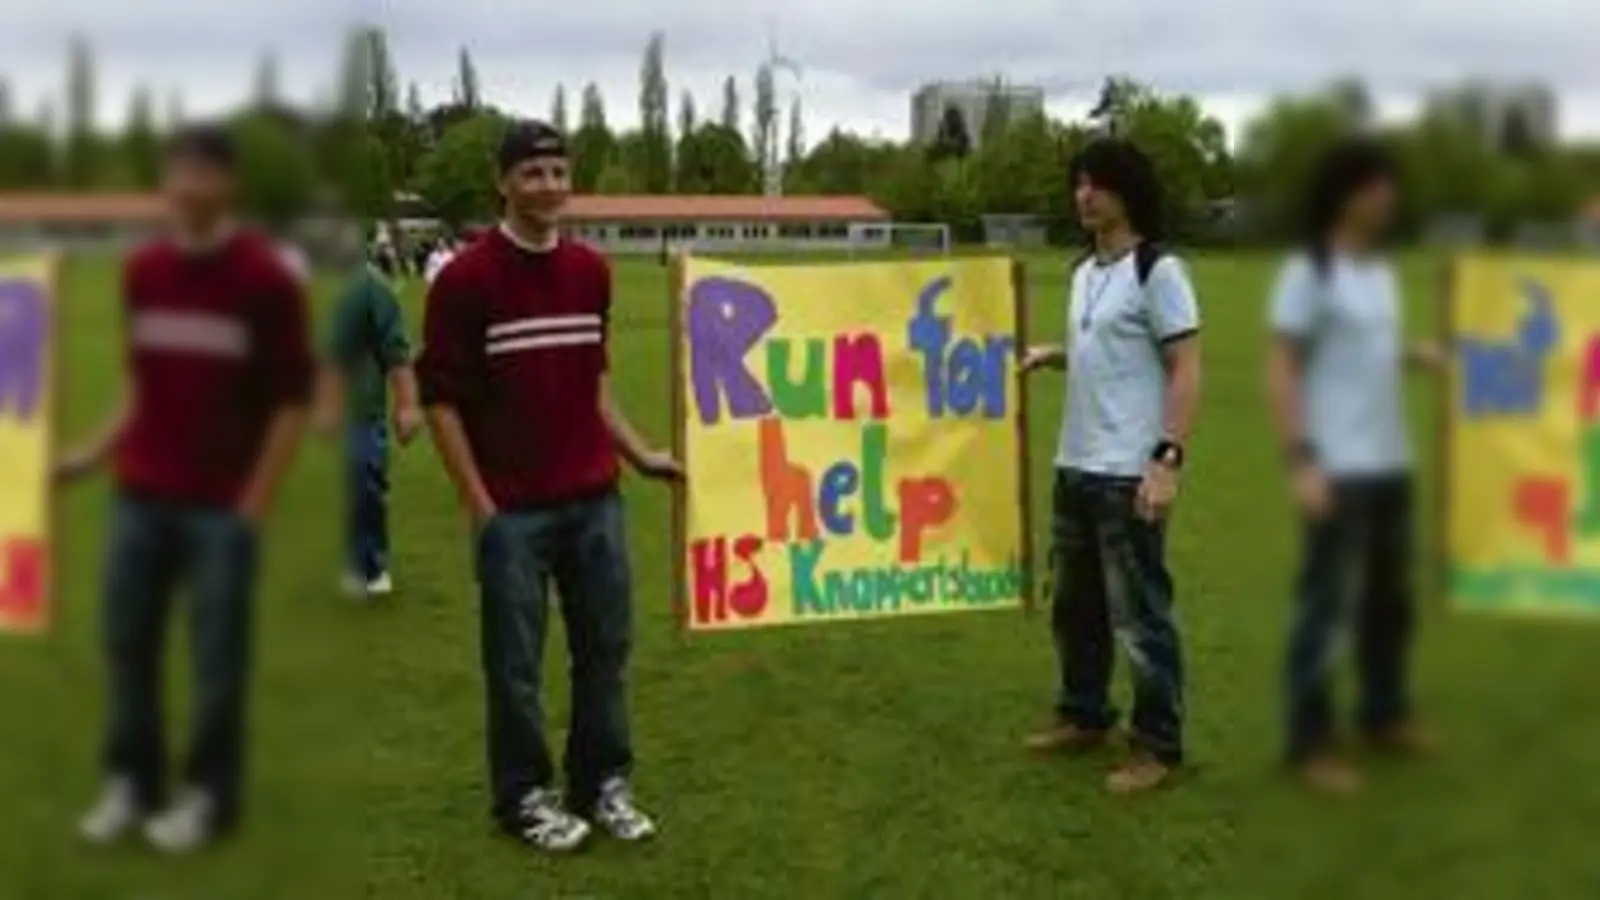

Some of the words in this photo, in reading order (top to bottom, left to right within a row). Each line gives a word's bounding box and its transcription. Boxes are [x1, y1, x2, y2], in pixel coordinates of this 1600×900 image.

[689, 276, 890, 425] Run
[908, 276, 1016, 420] for
[758, 415, 960, 564] help
[691, 533, 768, 624] HS
